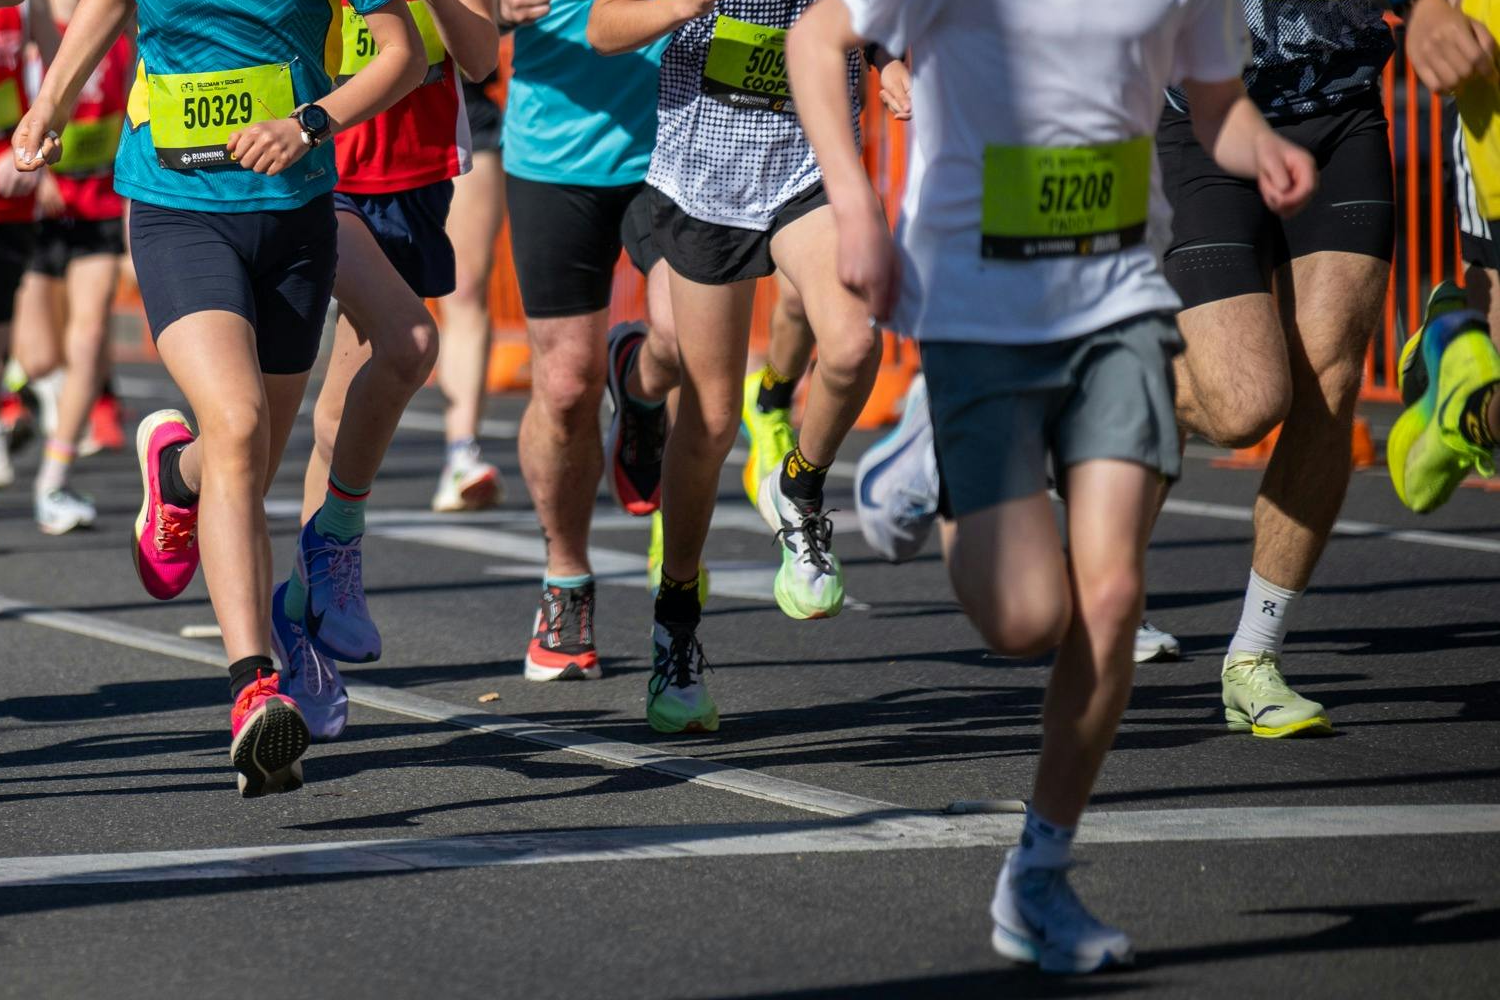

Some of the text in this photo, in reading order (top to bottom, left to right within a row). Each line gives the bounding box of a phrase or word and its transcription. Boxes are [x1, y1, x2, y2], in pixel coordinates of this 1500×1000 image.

[184, 91, 252, 130] 50329
[192, 150, 224, 160] RUNNING
[1039, 170, 1114, 214] 51208
